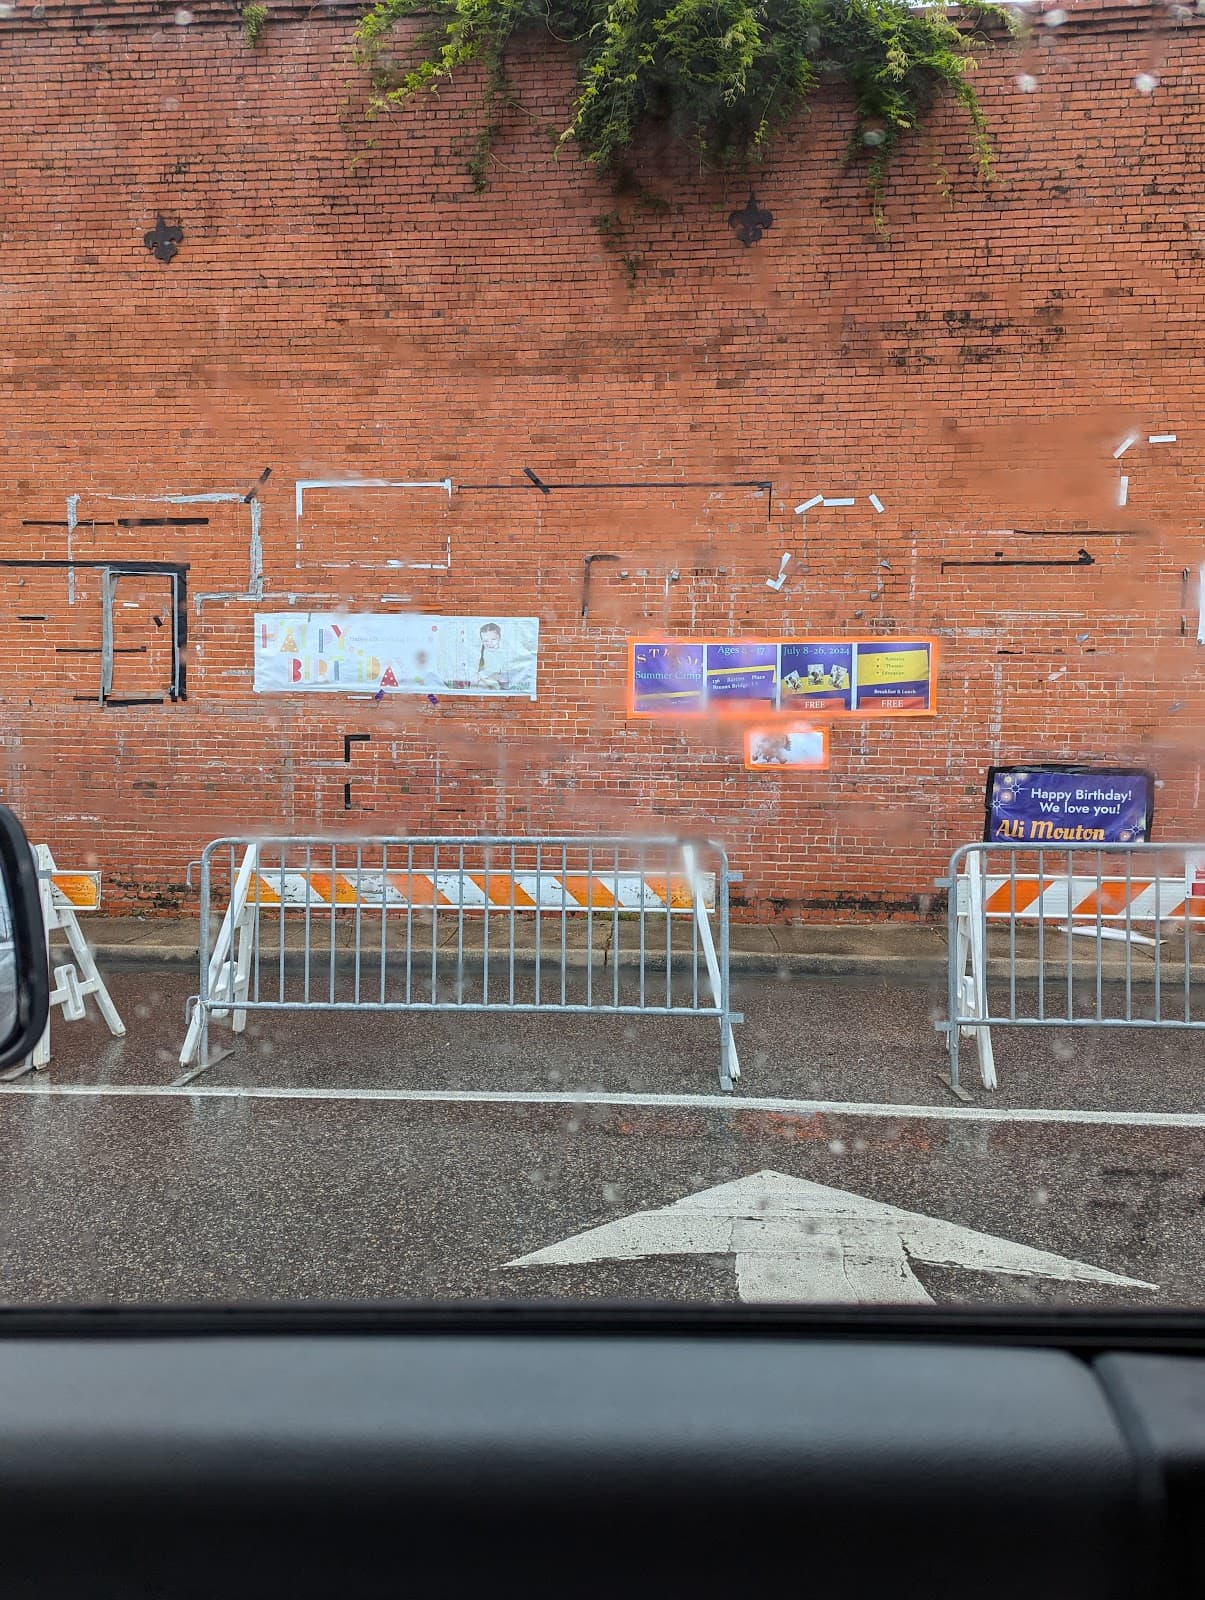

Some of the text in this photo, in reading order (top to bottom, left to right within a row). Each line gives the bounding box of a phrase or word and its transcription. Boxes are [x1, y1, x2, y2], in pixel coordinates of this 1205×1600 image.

[717, 646, 739, 656] Ages
[783, 646, 800, 656] July
[828, 647, 850, 656] 2024
[635, 670, 671, 680] Summer
[804, 701, 826, 709] FREE
[881, 699, 904, 708] FREE
[1031, 788, 1132, 803] Happy Birthday!
[1039, 801, 1121, 816] We love you!
[995, 818, 1106, 841] Ali Mouton
